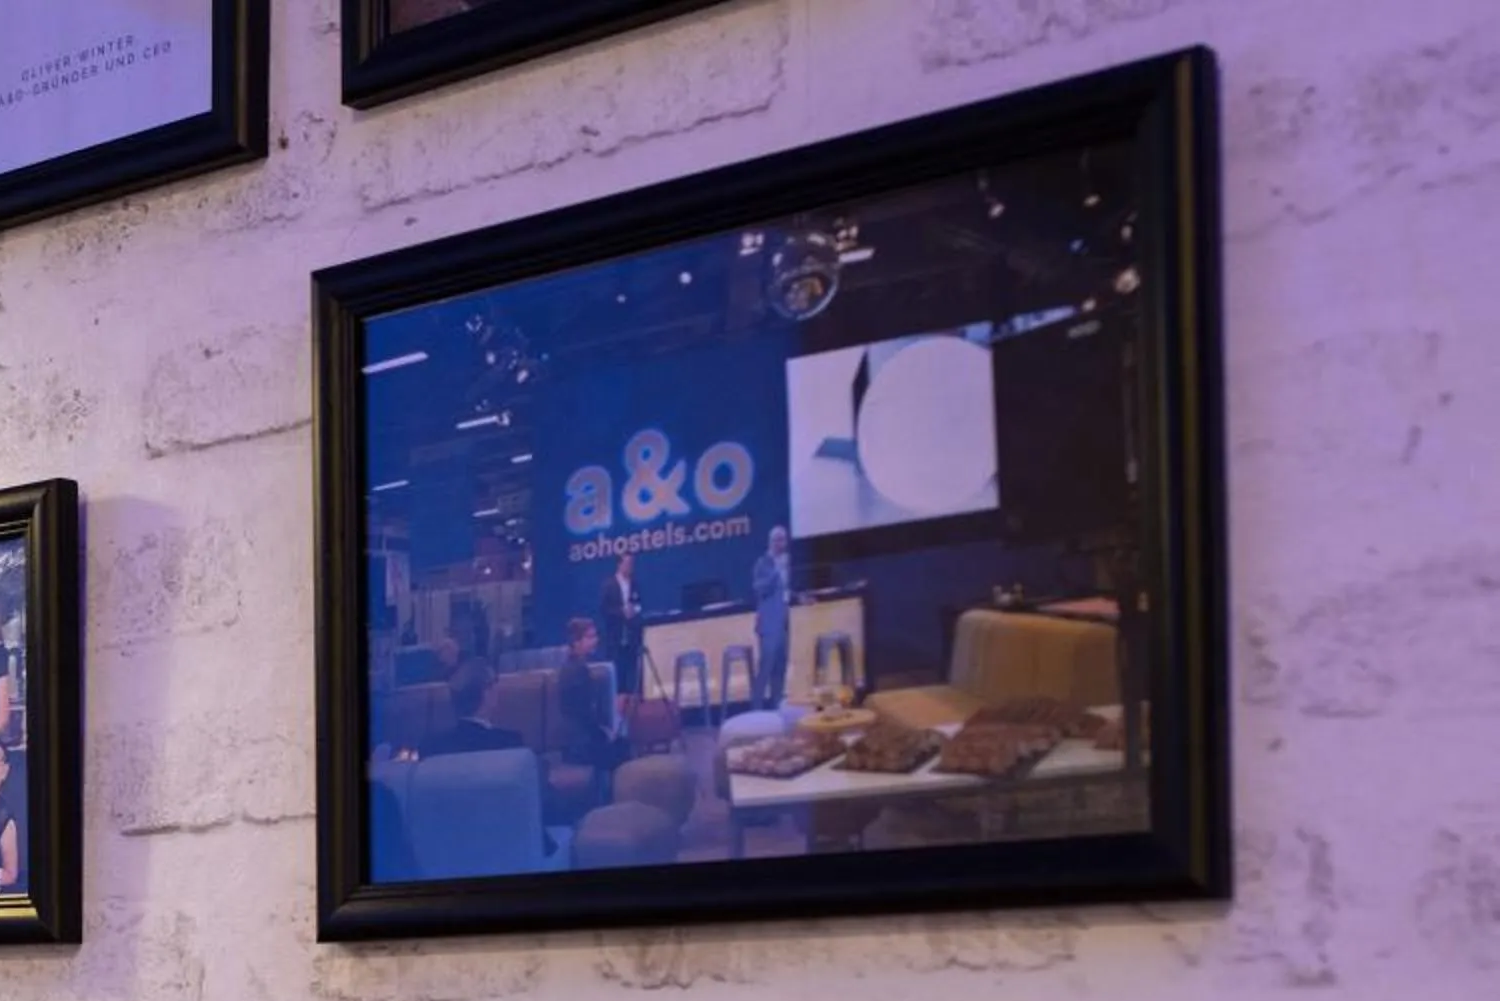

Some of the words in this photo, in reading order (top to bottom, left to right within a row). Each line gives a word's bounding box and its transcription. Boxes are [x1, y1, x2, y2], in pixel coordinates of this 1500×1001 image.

[21, 55, 71, 82] OLIVER
[79, 35, 134, 61] WINTER
[105, 52, 135, 71] UND
[143, 41, 171, 60] CEO
[565, 429, 754, 533] a&o
[569, 516, 750, 562] aohostels.com
